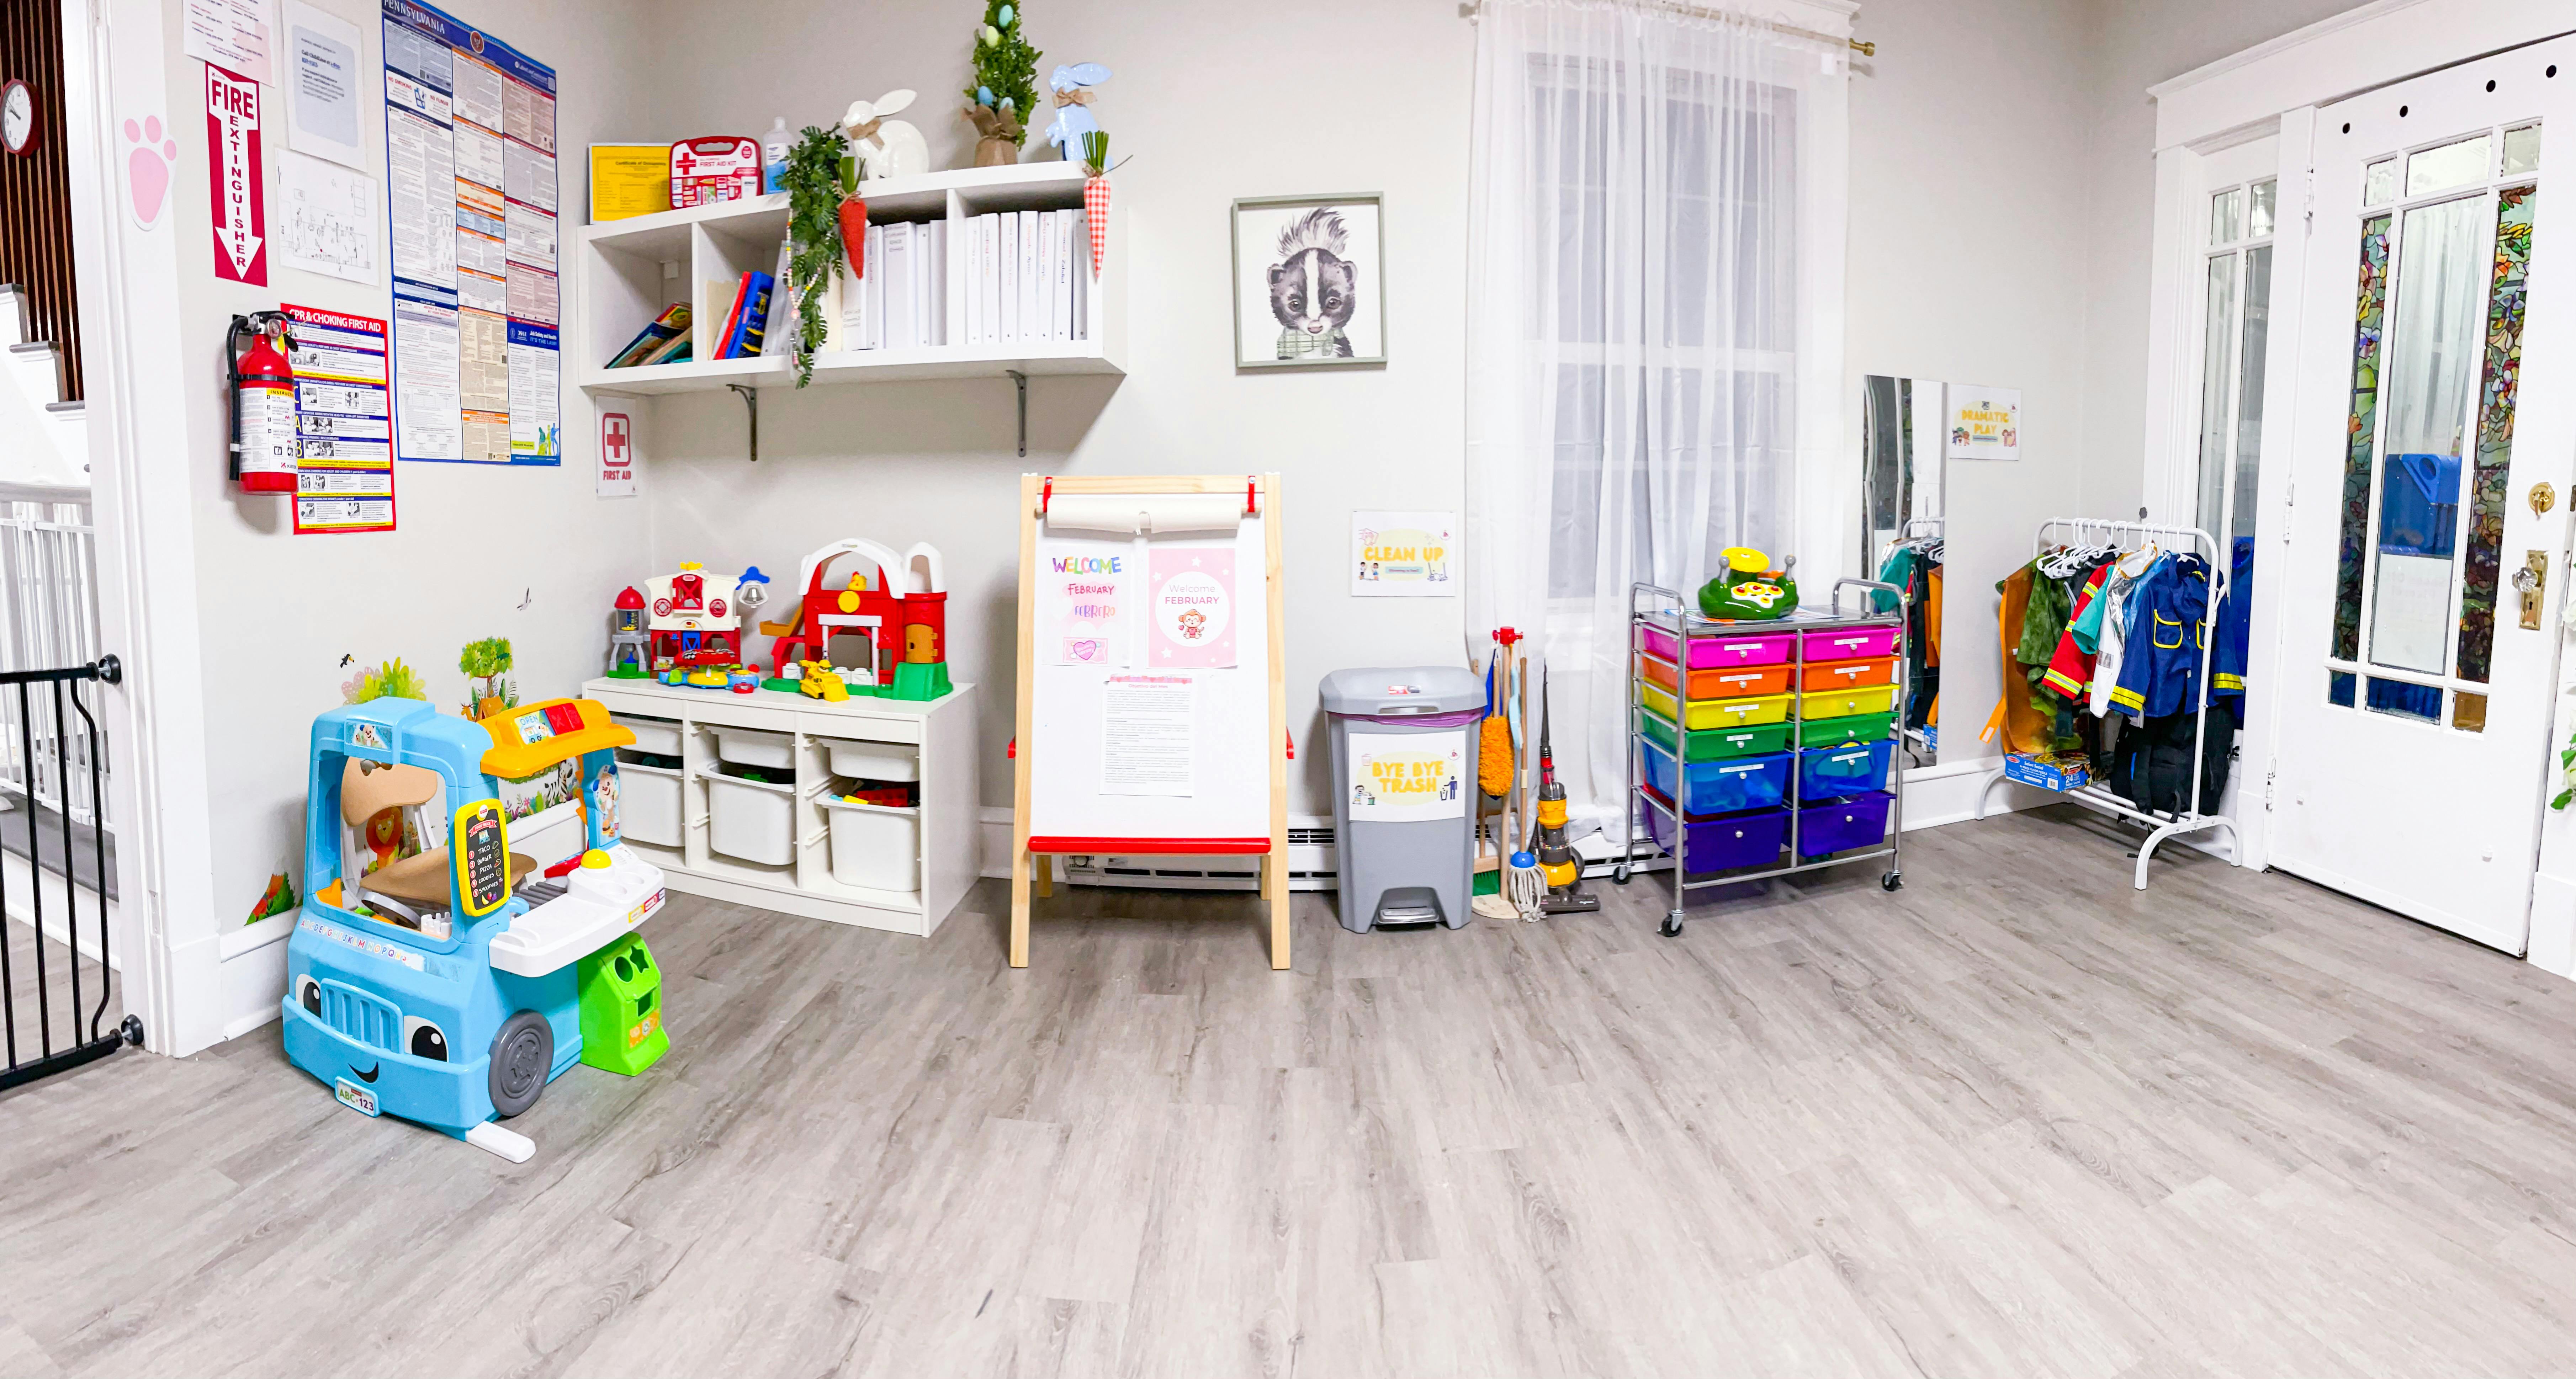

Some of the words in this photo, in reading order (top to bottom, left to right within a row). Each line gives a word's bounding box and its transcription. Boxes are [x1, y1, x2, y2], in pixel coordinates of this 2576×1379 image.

[384, 0, 445, 34] PENNSYLVANIA
[395, 79, 412, 90] SMOKING
[212, 79, 254, 120] FIRE
[230, 115, 246, 267] EXTINGUISHER
[306, 311, 312, 321] &
[313, 313, 348, 327] CHOKING
[349, 319, 367, 330] FIRST
[369, 322, 381, 332] AID
[1962, 409, 2009, 423] DRAMATIC
[296, 415, 302, 433] A
[1974, 423, 1997, 435] PLAY
[603, 470, 620, 480] FIRST
[622, 470, 631, 480] AID
[1364, 546, 1416, 562] CLEAN
[1423, 547, 1444, 562] UP
[1053, 556, 1121, 575] WELCOME
[1068, 584, 1114, 595] FEBRUARY
[1075, 605, 1115, 618] FEBRERO
[520, 715, 538, 725] OPEN
[1372, 762, 1405, 778] BYE
[1412, 760, 1444, 777] BYE
[1379, 777, 1437, 793] TRASH
[2066, 775, 2073, 783] 24
[478, 845, 490, 854] TACO
[477, 854, 492, 865] BURGER
[480, 864, 492, 874] PIZZA
[478, 872, 494, 884] COOKIES
[479, 880, 498, 894] SMOOTHIES
